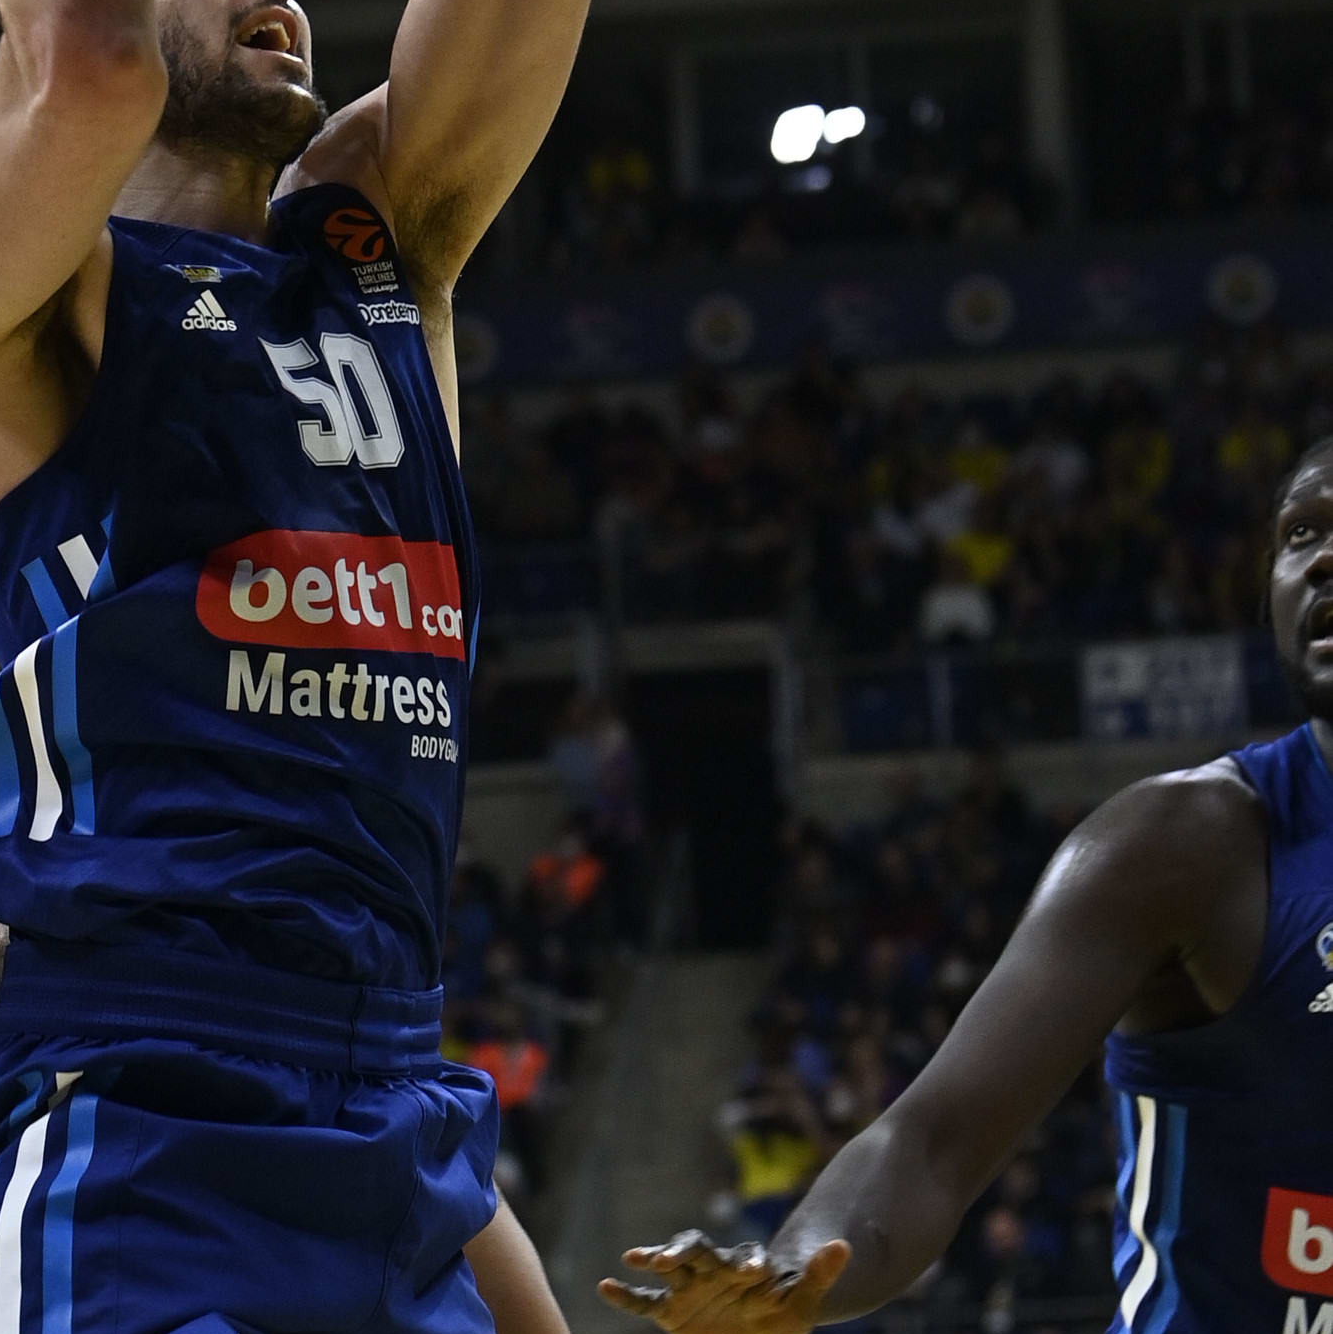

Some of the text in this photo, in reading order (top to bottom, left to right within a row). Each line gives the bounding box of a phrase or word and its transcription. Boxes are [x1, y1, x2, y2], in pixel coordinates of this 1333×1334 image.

[181, 315, 238, 332] adidas
[258, 332, 406, 470] 50
[225, 649, 452, 728] Mattress
